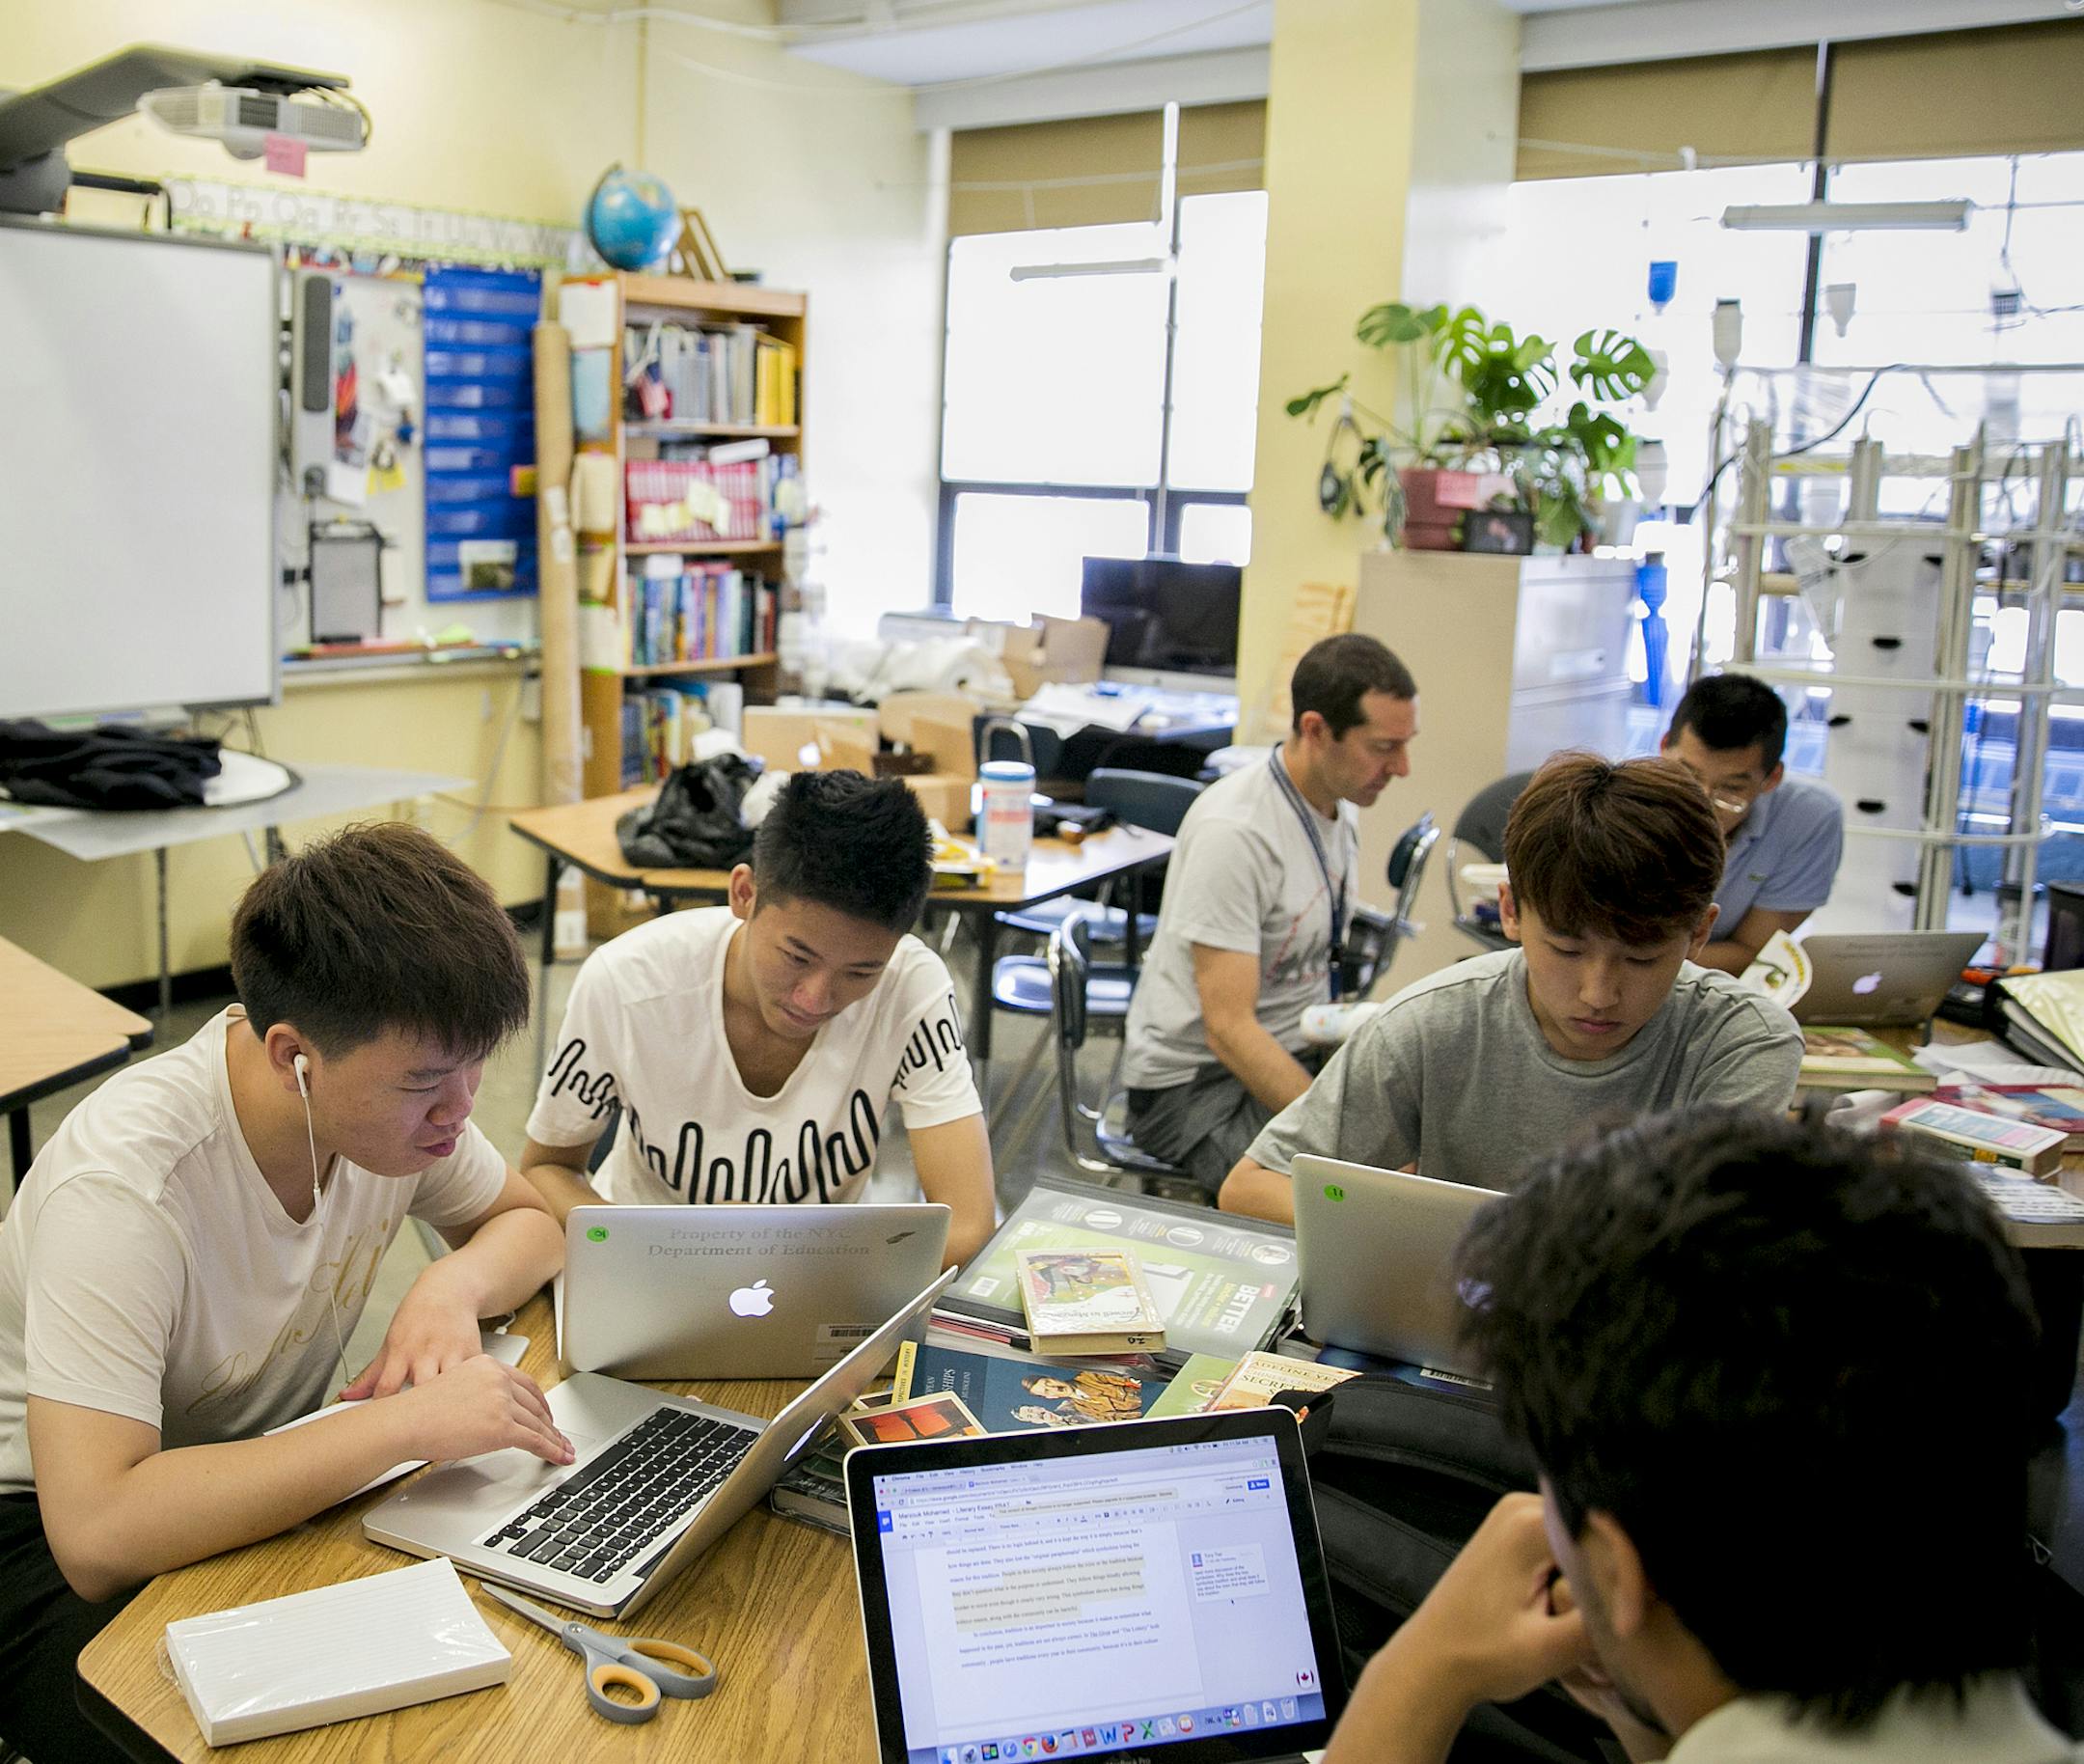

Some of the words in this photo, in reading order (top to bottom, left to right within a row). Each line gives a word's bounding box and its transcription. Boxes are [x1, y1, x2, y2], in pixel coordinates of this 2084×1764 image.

[672, 1228, 746, 1242] Property
[752, 1228, 772, 1240] of
[777, 1228, 804, 1240] the
[648, 1244, 754, 1258] Department
[757, 1244, 779, 1256] of
[784, 1244, 871, 1256] Education
[1214, 1283, 1261, 1333] BETTER
[1253, 1361, 1310, 1377] ADELINE
[941, 1368, 956, 1391] SHIPS
